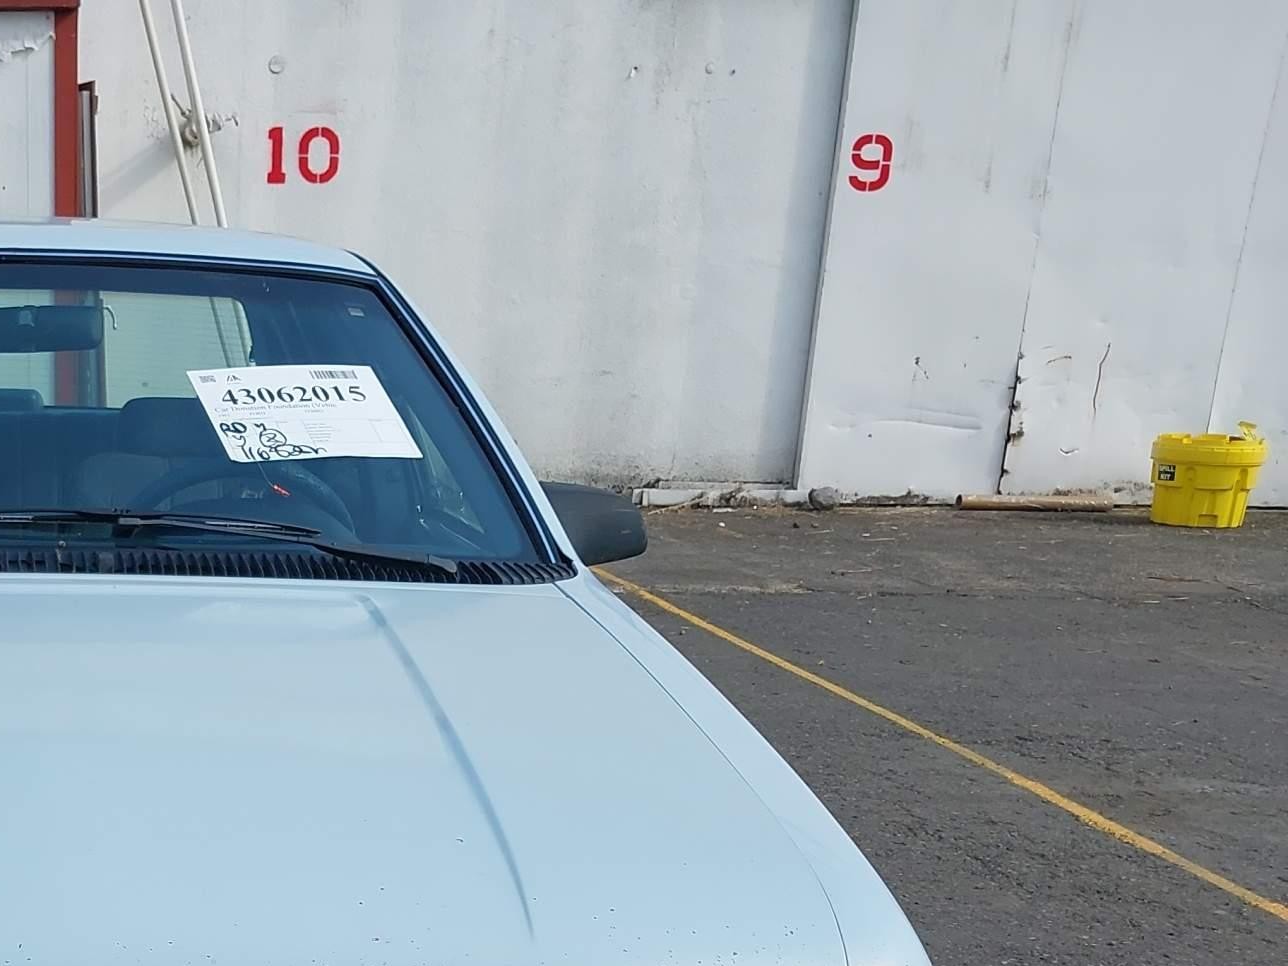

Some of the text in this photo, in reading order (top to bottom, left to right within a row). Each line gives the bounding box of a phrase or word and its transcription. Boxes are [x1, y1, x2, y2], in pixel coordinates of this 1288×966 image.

[267, 126, 340, 184] 10
[848, 134, 893, 192] 9
[222, 386, 367, 405] 43062015
